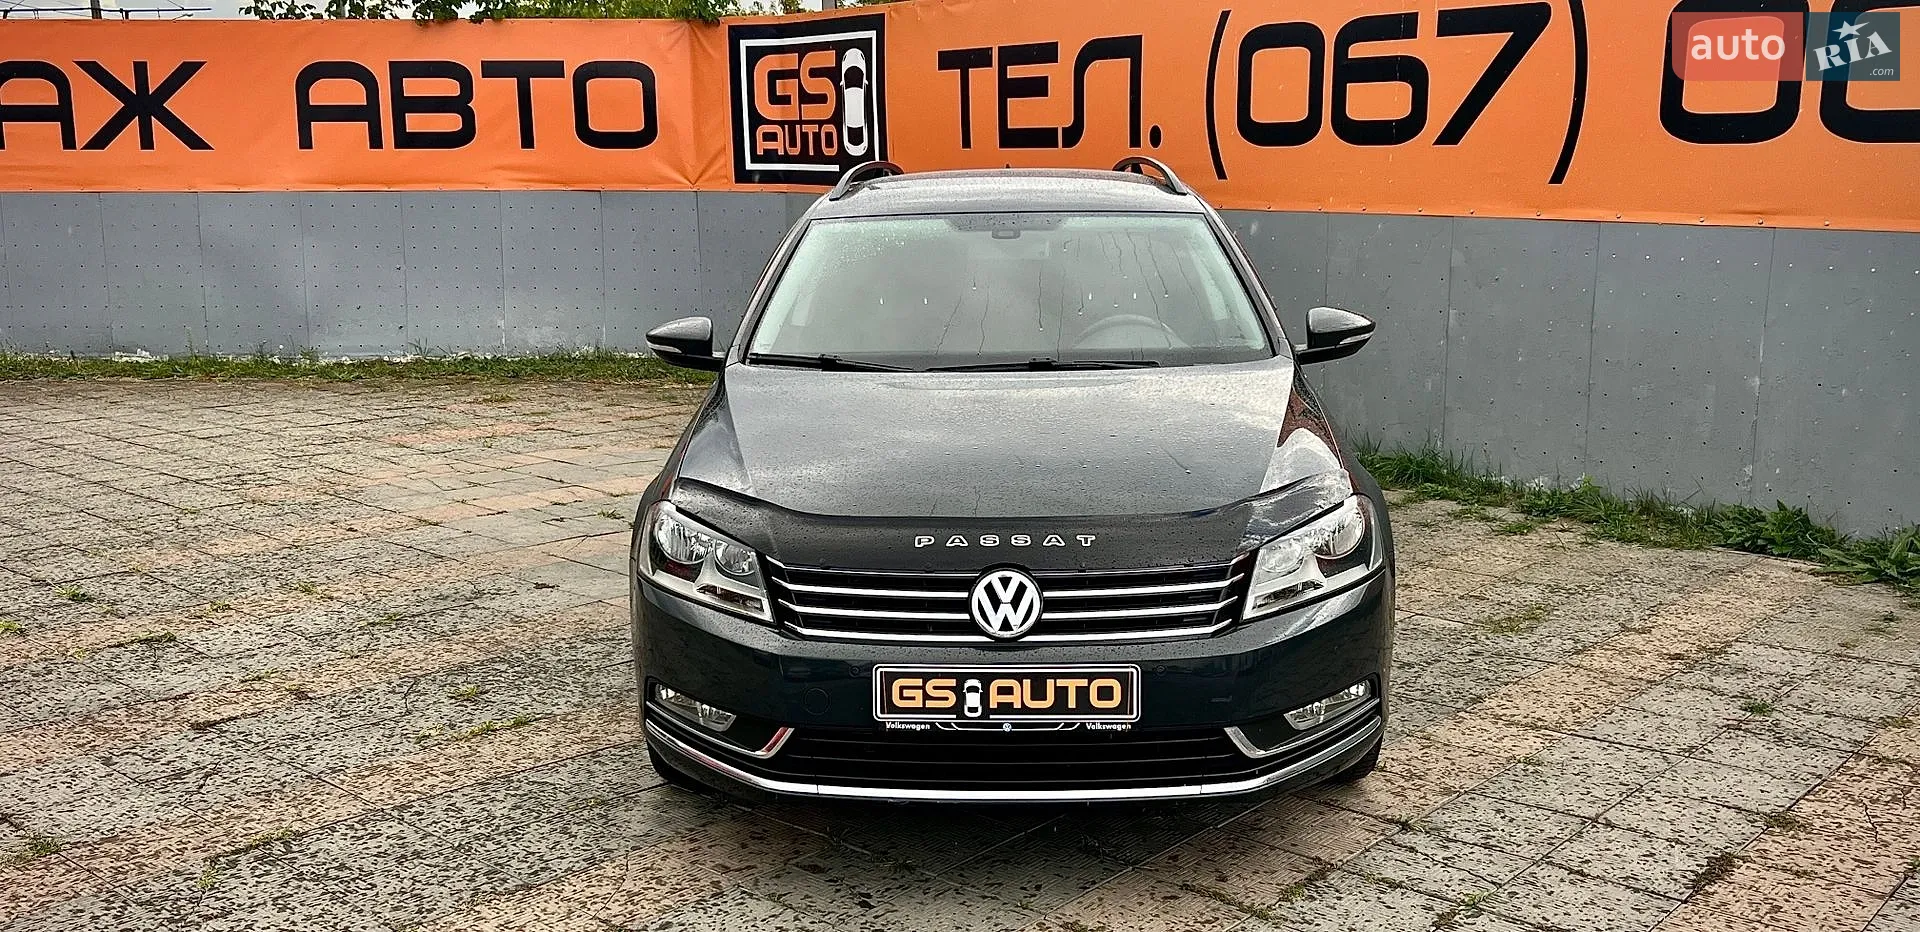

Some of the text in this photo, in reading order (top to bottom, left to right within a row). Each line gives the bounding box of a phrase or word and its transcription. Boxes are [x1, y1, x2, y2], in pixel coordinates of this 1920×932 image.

[295, 59, 659, 150] АВТО
[753, 50, 836, 121] GS
[937, 34, 1163, 150] ТЕЛ.
[1205, 0, 1588, 185] (067)
[756, 124, 838, 156] AUTO
[914, 534, 1096, 547] PASSAT
[973, 570, 1039, 636] VW
[891, 678, 1122, 709] GS AUTO
[885, 721, 1132, 731] Volkswagen Volkswagen
